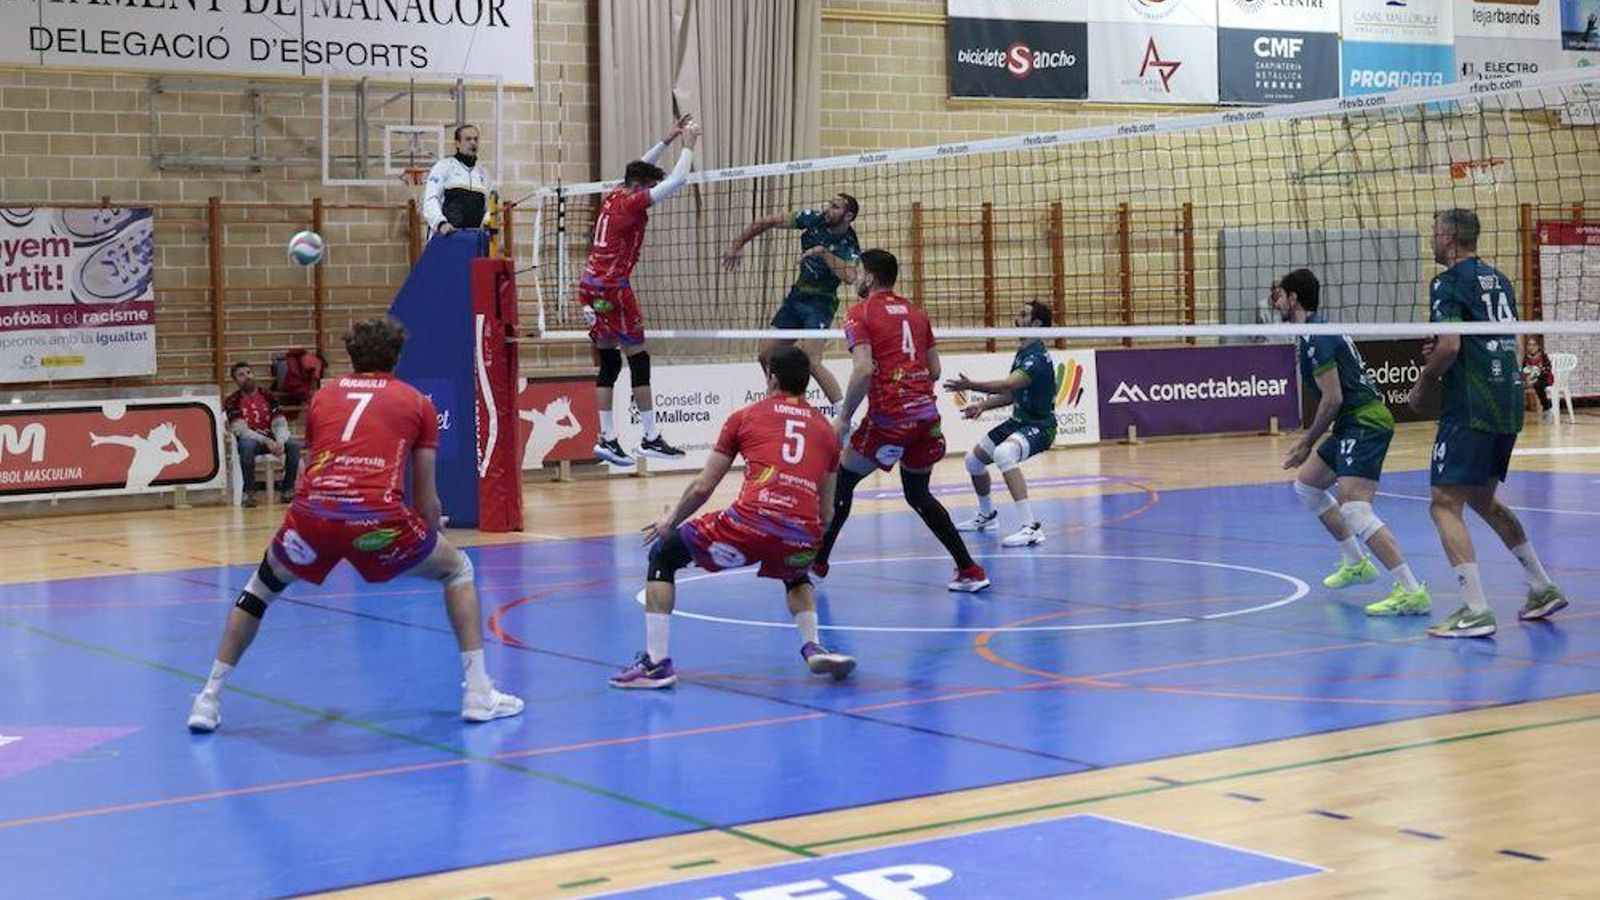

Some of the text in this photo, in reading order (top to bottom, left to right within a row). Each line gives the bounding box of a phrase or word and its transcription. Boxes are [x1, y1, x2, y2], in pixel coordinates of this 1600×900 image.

[1473, 8, 1540, 26] tejarbandris
[29, 26, 429, 69] DELEGACIÓ D'ESPORTS
[1253, 36, 1304, 58] CMF
[1484, 61, 1539, 74] ELECTRO
[1350, 69, 1443, 88] PROADATA
[1470, 79, 1522, 93] rfevb.com
[1338, 95, 1386, 109] rfevb.com
[1222, 110, 1265, 122] rfevb.com
[1117, 122, 1156, 135] rfevb.com
[594, 213, 609, 247] 11
[1481, 292, 1517, 322] 14
[63, 309, 79, 325] el
[82, 308, 149, 324] racisme
[96, 330, 148, 347] igualtat
[901, 319, 916, 361] 4
[1149, 375, 1288, 401] conectabalear
[655, 390, 720, 407] Consell de
[341, 392, 374, 442] 7
[655, 410, 710, 424] Mallorca
[781, 419, 806, 464] 5
[1340, 439, 1356, 455] 17
[1433, 442, 1446, 461] 14
[23, 466, 83, 482] MASCULINA
